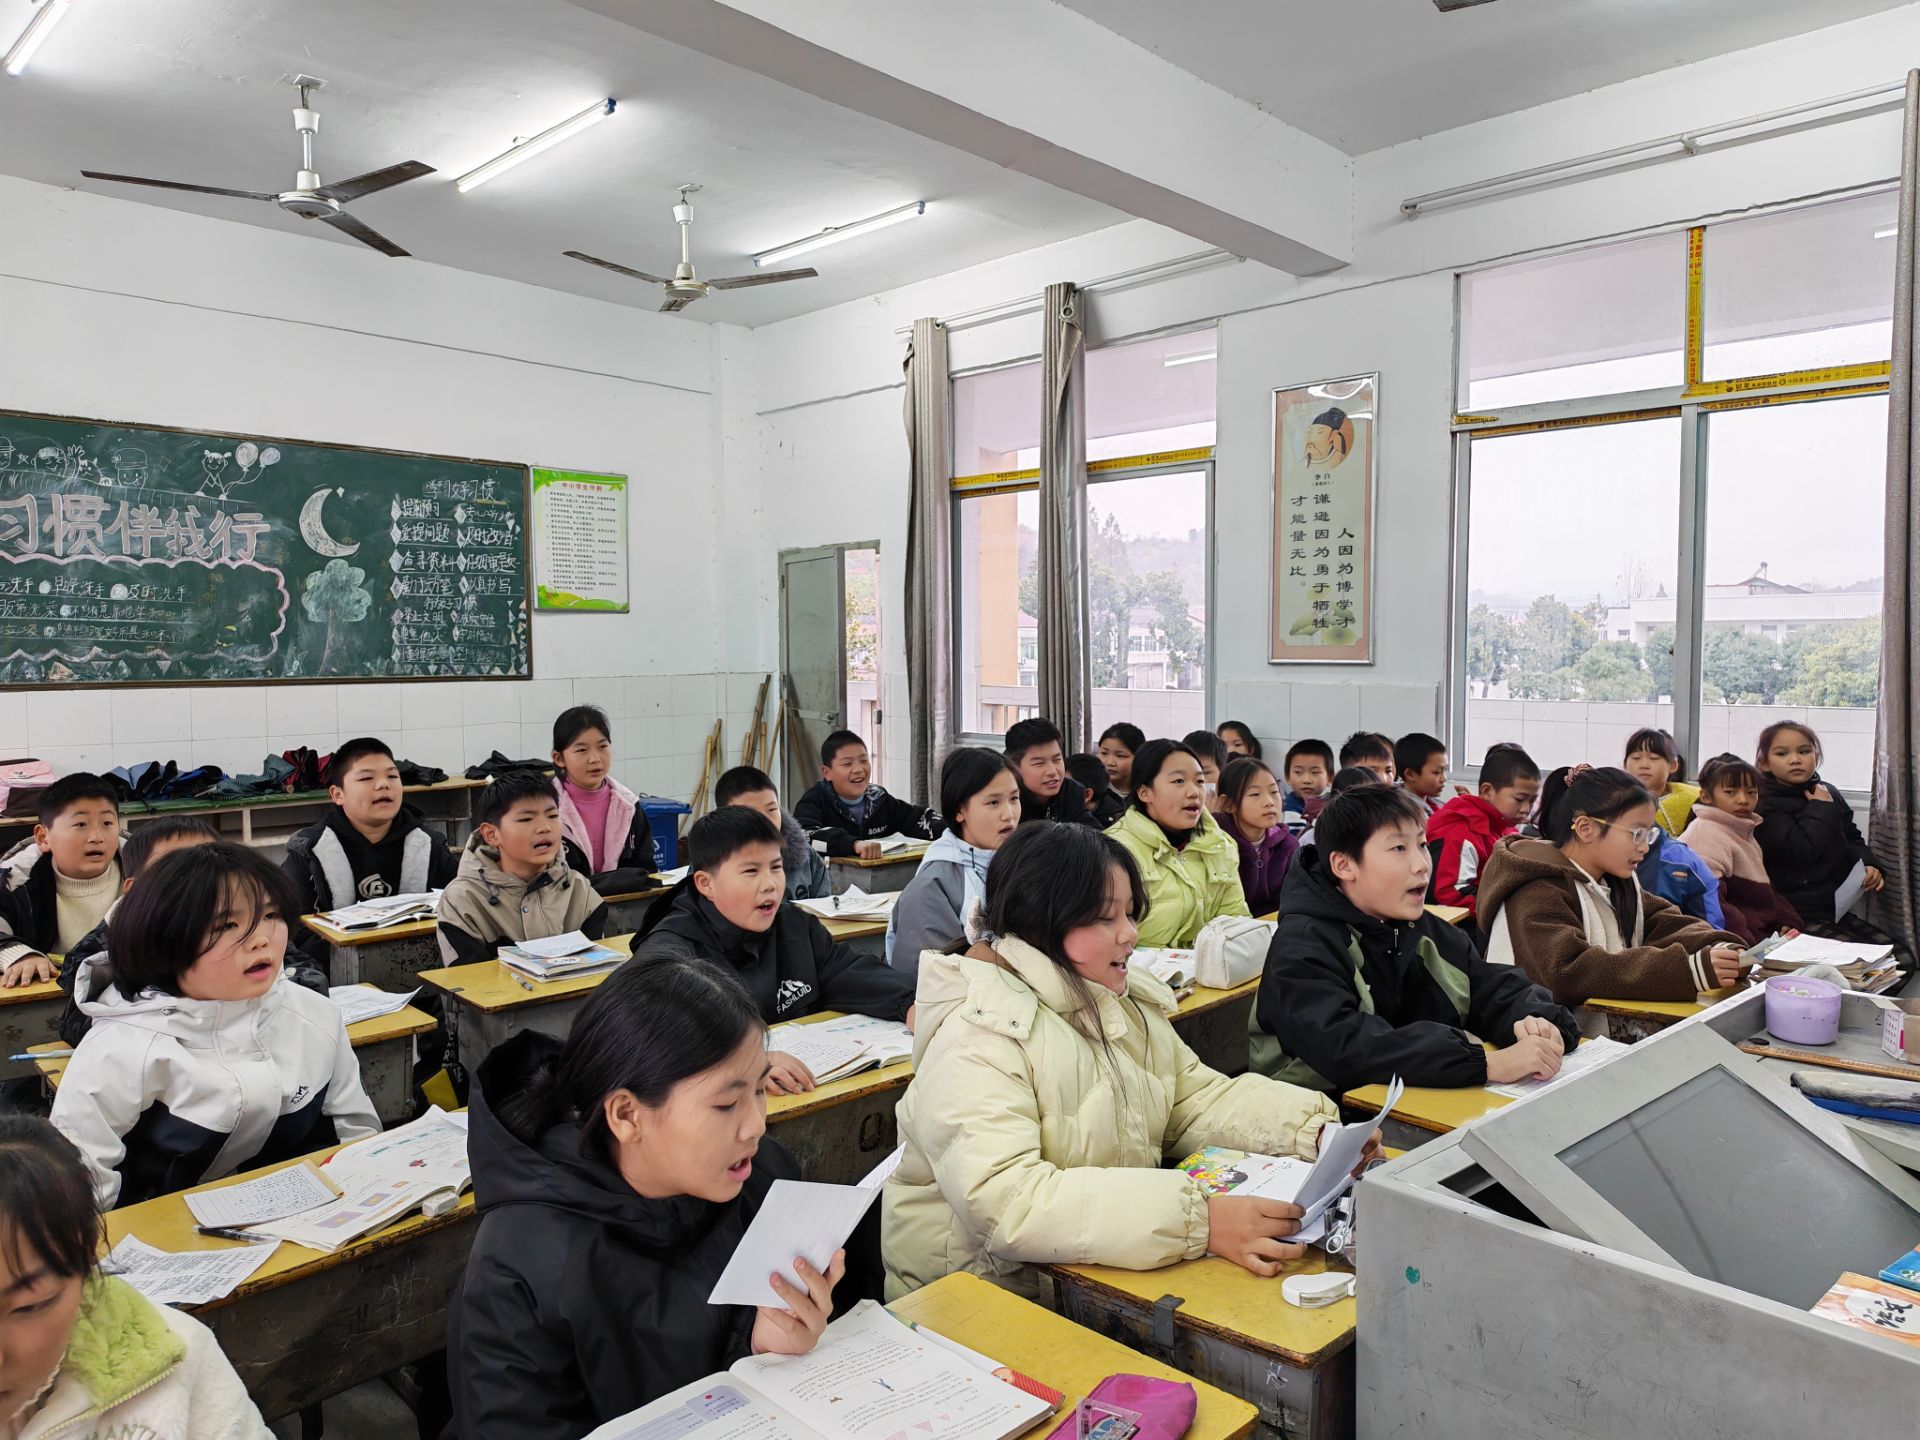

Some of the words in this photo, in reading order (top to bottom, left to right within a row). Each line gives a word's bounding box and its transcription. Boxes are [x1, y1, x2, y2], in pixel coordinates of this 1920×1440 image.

[0, 493, 270, 561] 习惯伴我行
[400, 522, 450, 543] 爱提问题
[776, 984, 812, 1014] FASHLUID
